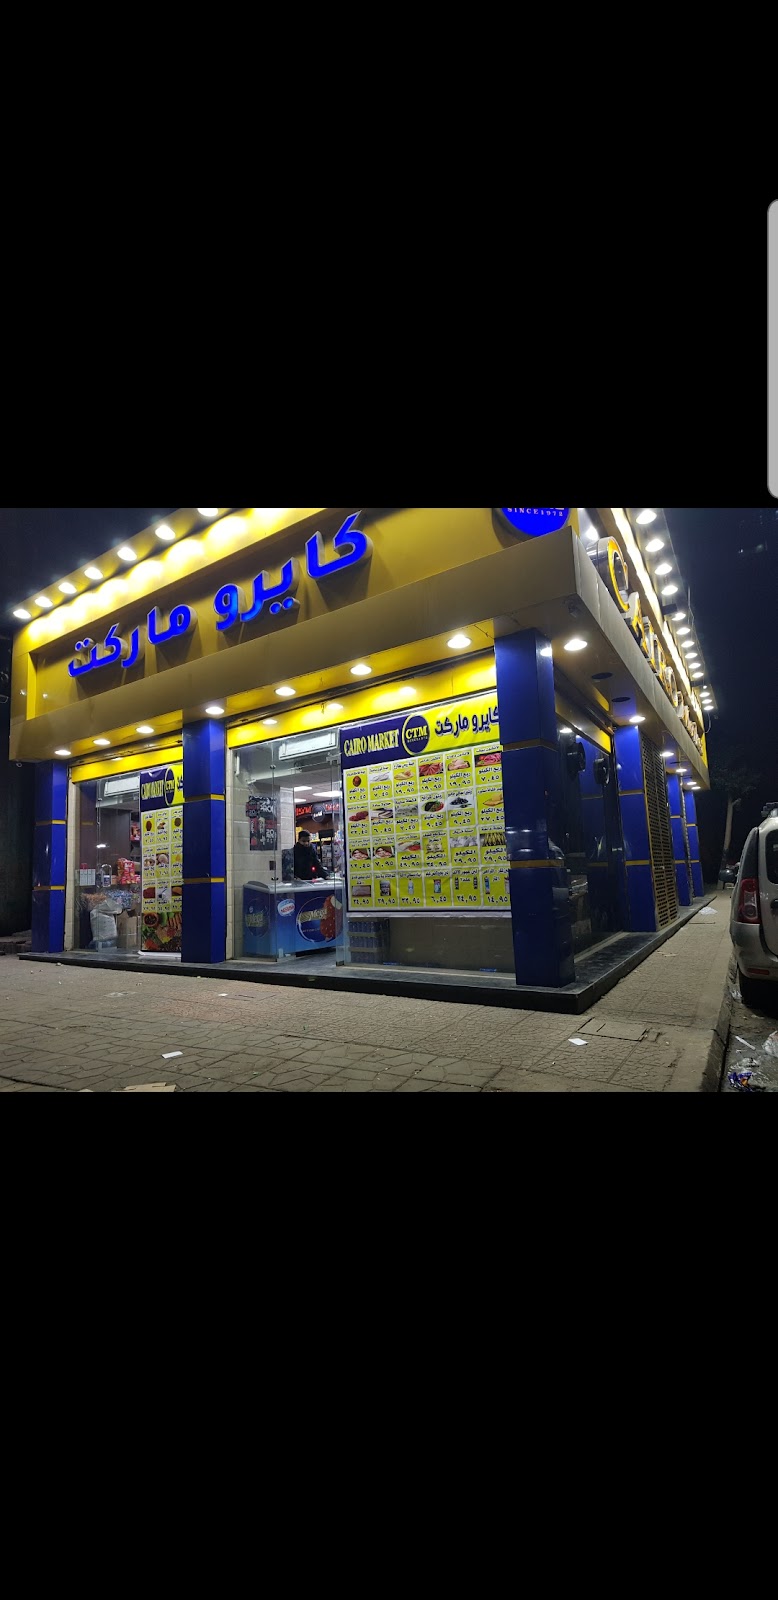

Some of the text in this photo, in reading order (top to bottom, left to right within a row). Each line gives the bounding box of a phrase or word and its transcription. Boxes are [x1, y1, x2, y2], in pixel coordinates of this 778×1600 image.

[67, 511, 370, 678] كايرو ماركت
[405, 725, 428, 740] CTM
[435, 714, 470, 738] ماركت
[344, 729, 400, 757] CAIRO MARKET
